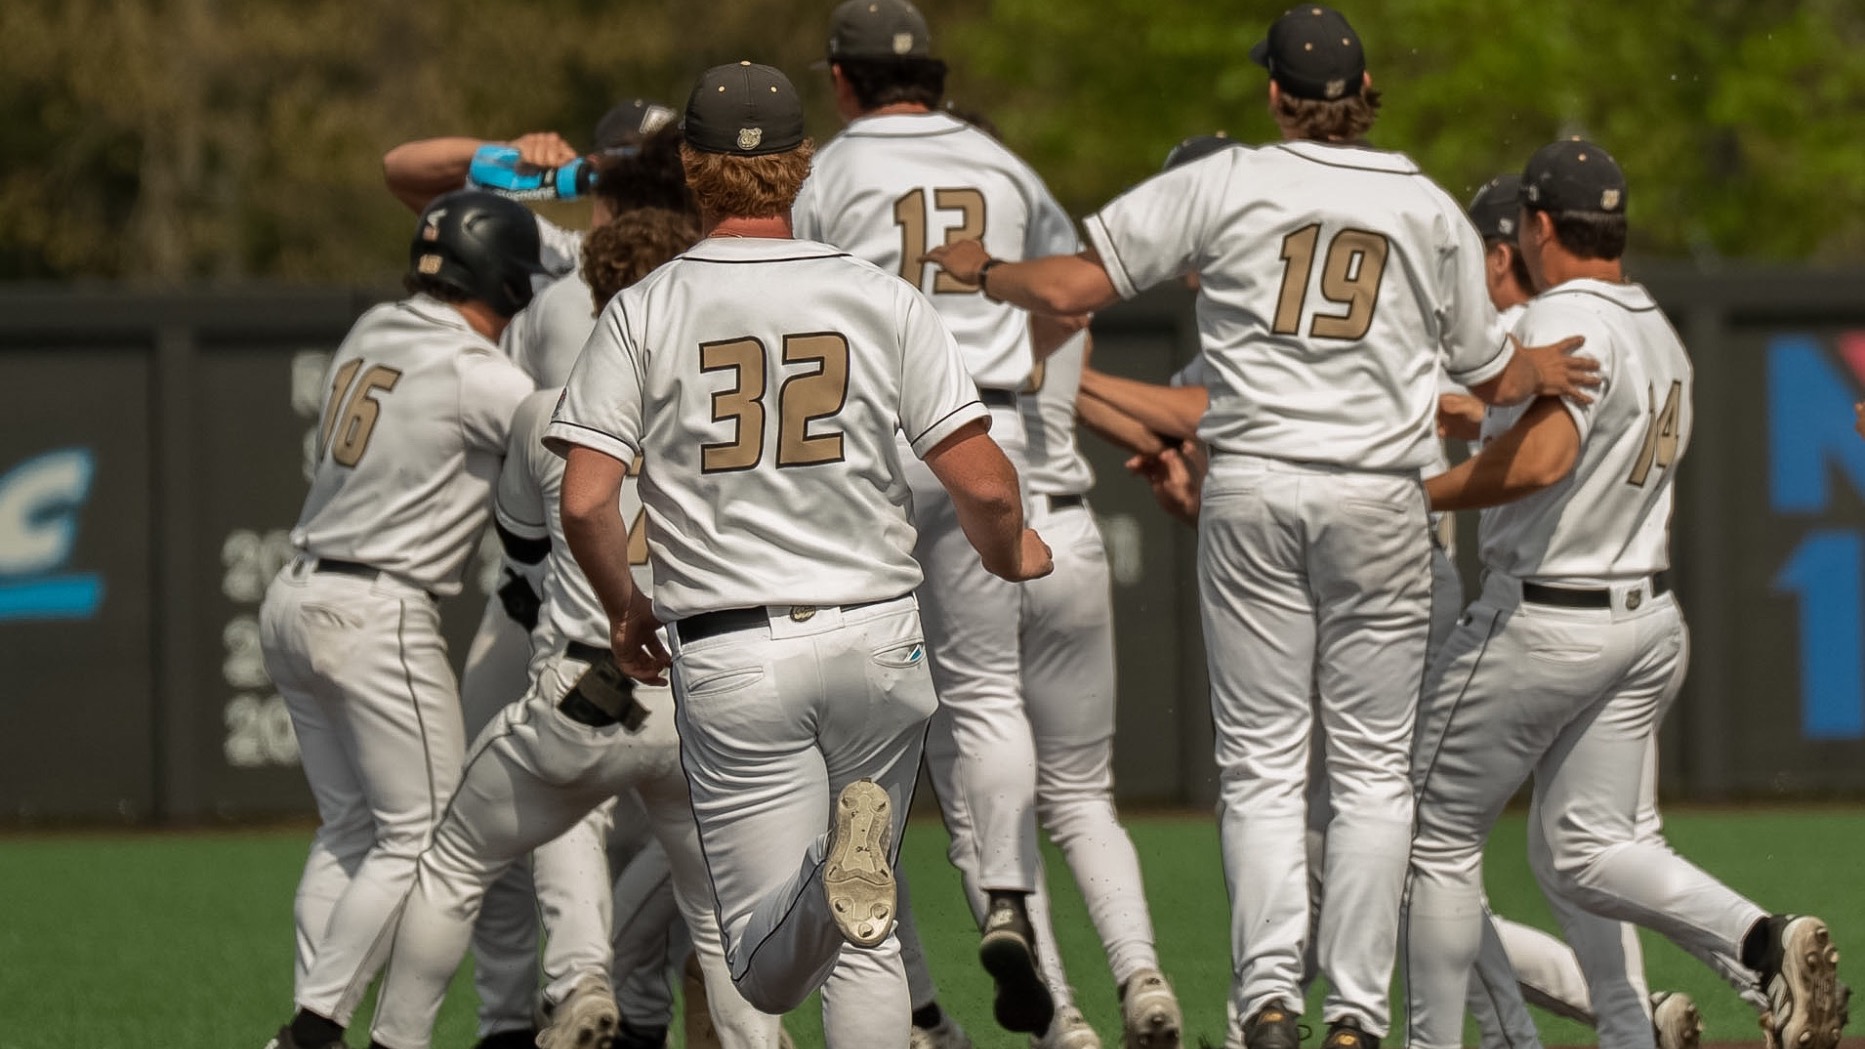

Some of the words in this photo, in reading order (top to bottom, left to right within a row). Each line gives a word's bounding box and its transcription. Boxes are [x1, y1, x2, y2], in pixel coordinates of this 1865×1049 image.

[893, 187, 987, 294] 13
[1271, 222, 1389, 341] 19
[319, 357, 402, 470] 16
[699, 331, 850, 475] 32
[1627, 378, 1682, 489] 14
